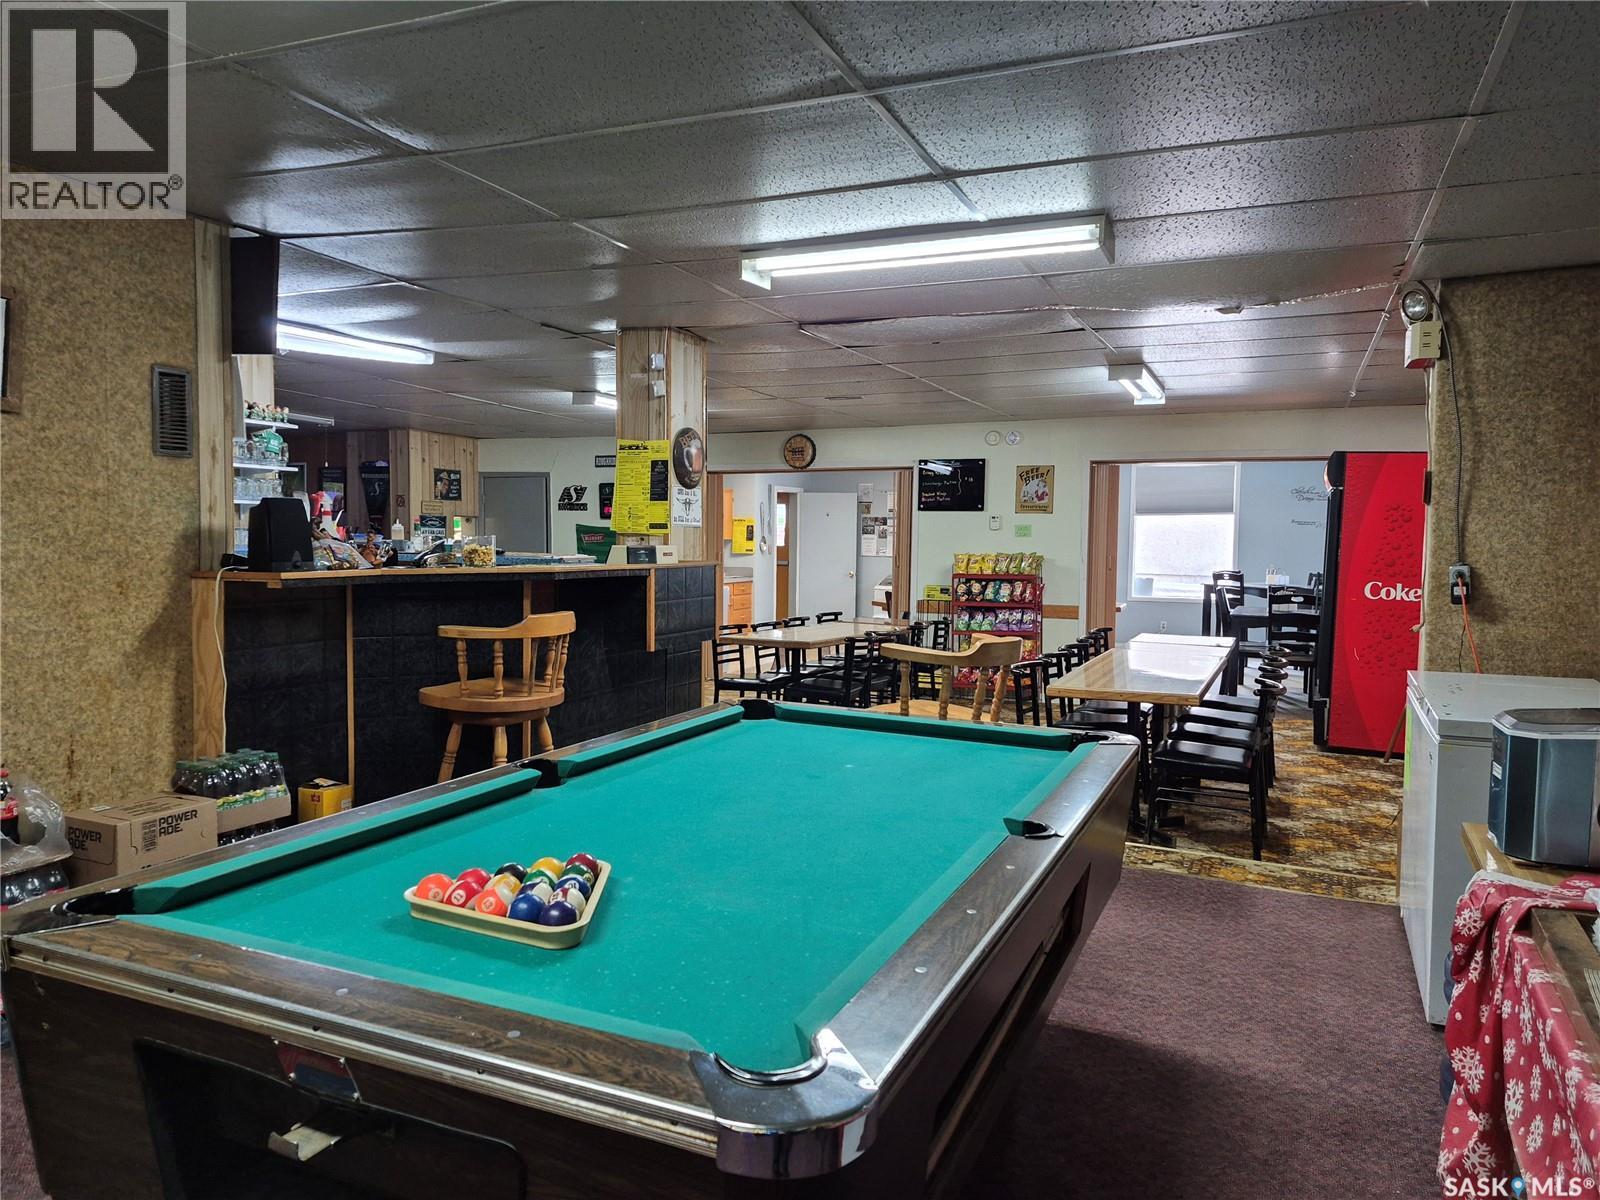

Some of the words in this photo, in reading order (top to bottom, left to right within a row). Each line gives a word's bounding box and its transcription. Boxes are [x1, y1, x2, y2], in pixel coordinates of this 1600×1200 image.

[1019, 466, 1040, 483] FREE
[1364, 581, 1423, 602] Coke
[159, 809, 198, 828] POWER
[67, 826, 102, 844] POWER
